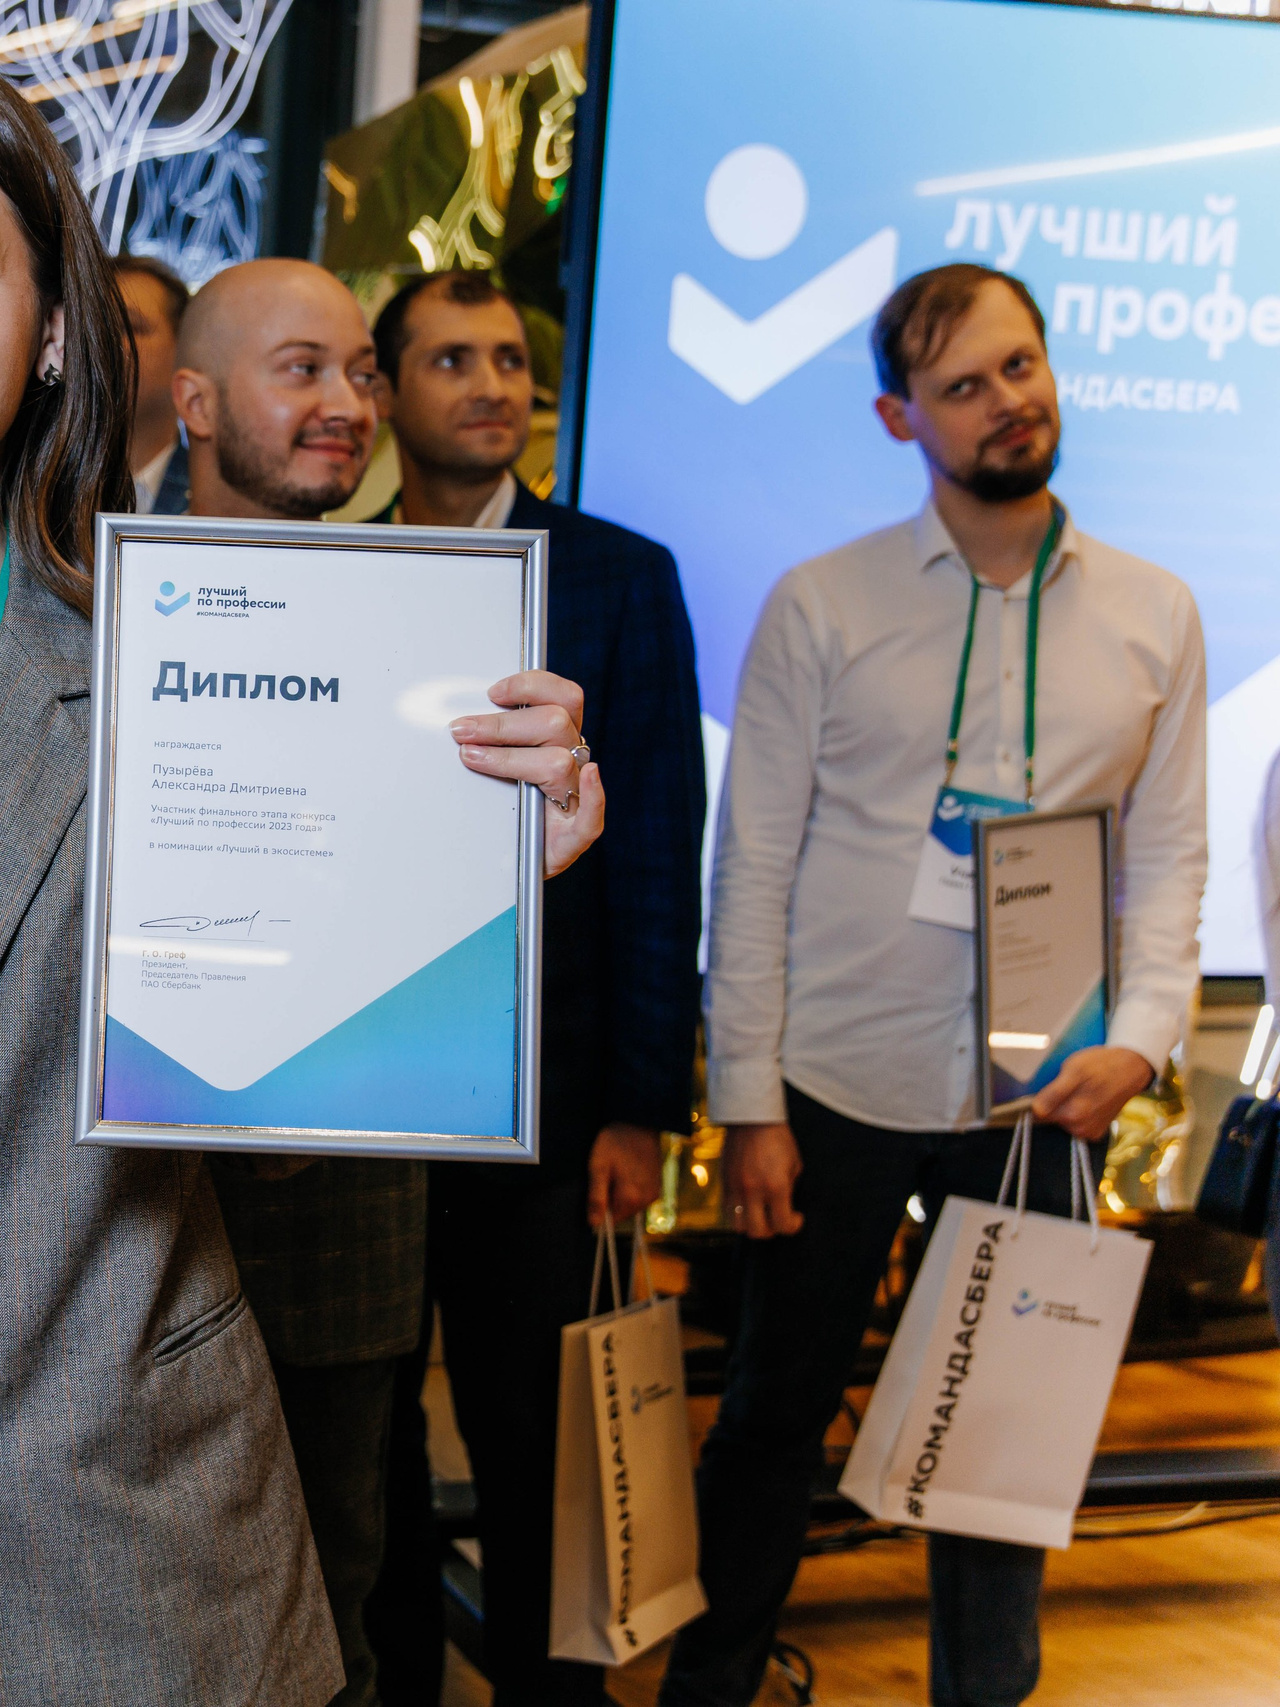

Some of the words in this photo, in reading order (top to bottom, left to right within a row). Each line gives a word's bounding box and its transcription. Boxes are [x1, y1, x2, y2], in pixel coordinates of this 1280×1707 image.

[943, 192, 1239, 272] лучший
[198, 586, 247, 598] лучший
[197, 598, 213, 606] по
[216, 598, 286, 610] профессии
[152, 660, 339, 703] Диплом
[154, 740, 222, 751] награждается
[152, 763, 214, 778] Пузырёва
[151, 779, 226, 794] Александра
[229, 782, 307, 796] Дмитриевна
[150, 804, 196, 815] Участник
[199, 806, 258, 818] финального
[260, 810, 288, 819] этапа
[290, 812, 336, 822] конкурса
[150, 816, 195, 827] «Лучший
[197, 819, 210, 827] по
[212, 819, 266, 830] профессии
[269, 821, 293, 831] 2023
[295, 823, 323, 833] года»
[157, 842, 213, 853] номинации
[216, 844, 260, 855] «Лучший
[271, 848, 334, 858] экосистеме»
[994, 882, 1052, 907] Диплом
[142, 950, 150, 958] Г.
[152, 950, 162, 958] О.
[164, 951, 187, 960] Греф
[141, 960, 188, 970] Президент,
[141, 970, 199, 980] Председатель
[201, 972, 247, 982] Правления
[141, 980, 160, 988] ПАО
[161, 981, 201, 990] Сбербанк
[904, 1219, 1005, 1520] #КОМАНДАСБЕРА
